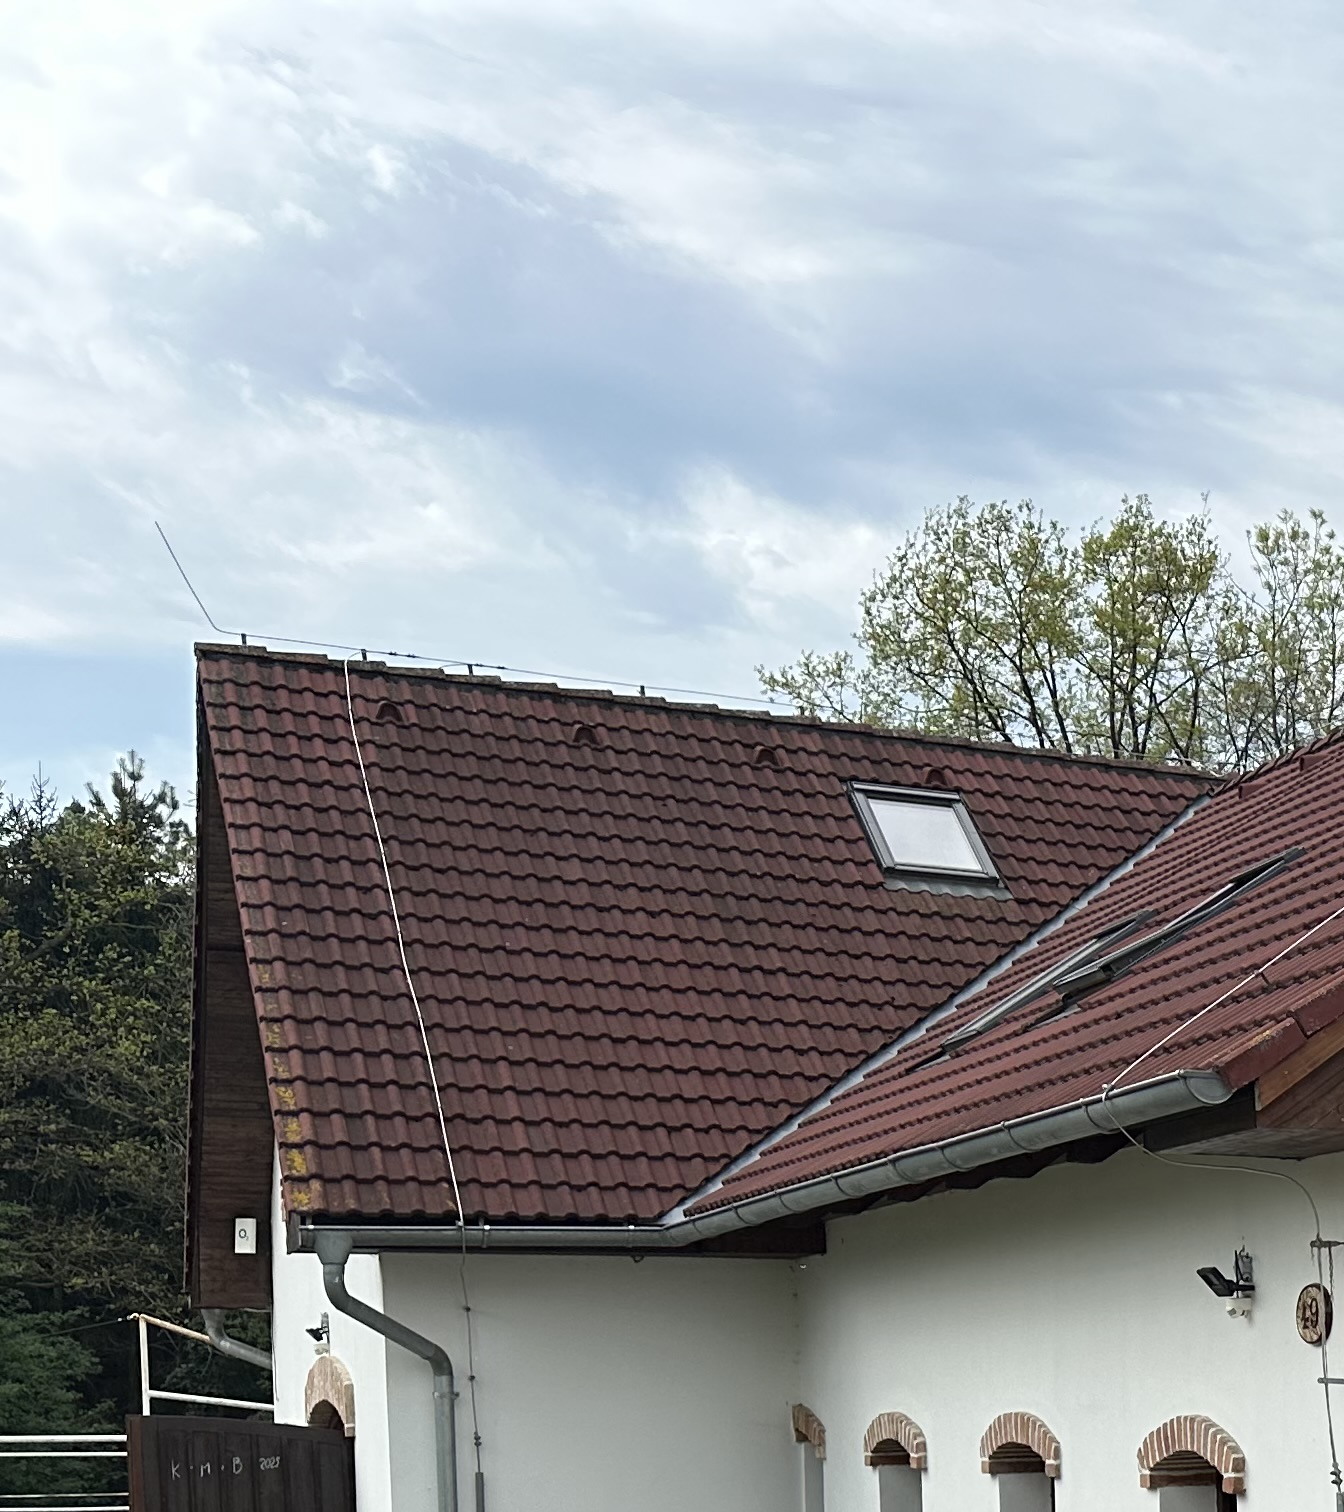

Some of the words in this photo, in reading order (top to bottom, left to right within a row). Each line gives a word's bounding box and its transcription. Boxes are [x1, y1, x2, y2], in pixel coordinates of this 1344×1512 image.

[171, 1459, 181, 1480] K
[200, 1462, 211, 1478] M
[232, 1456, 244, 1475] B
[259, 1456, 281, 1471] 2025
